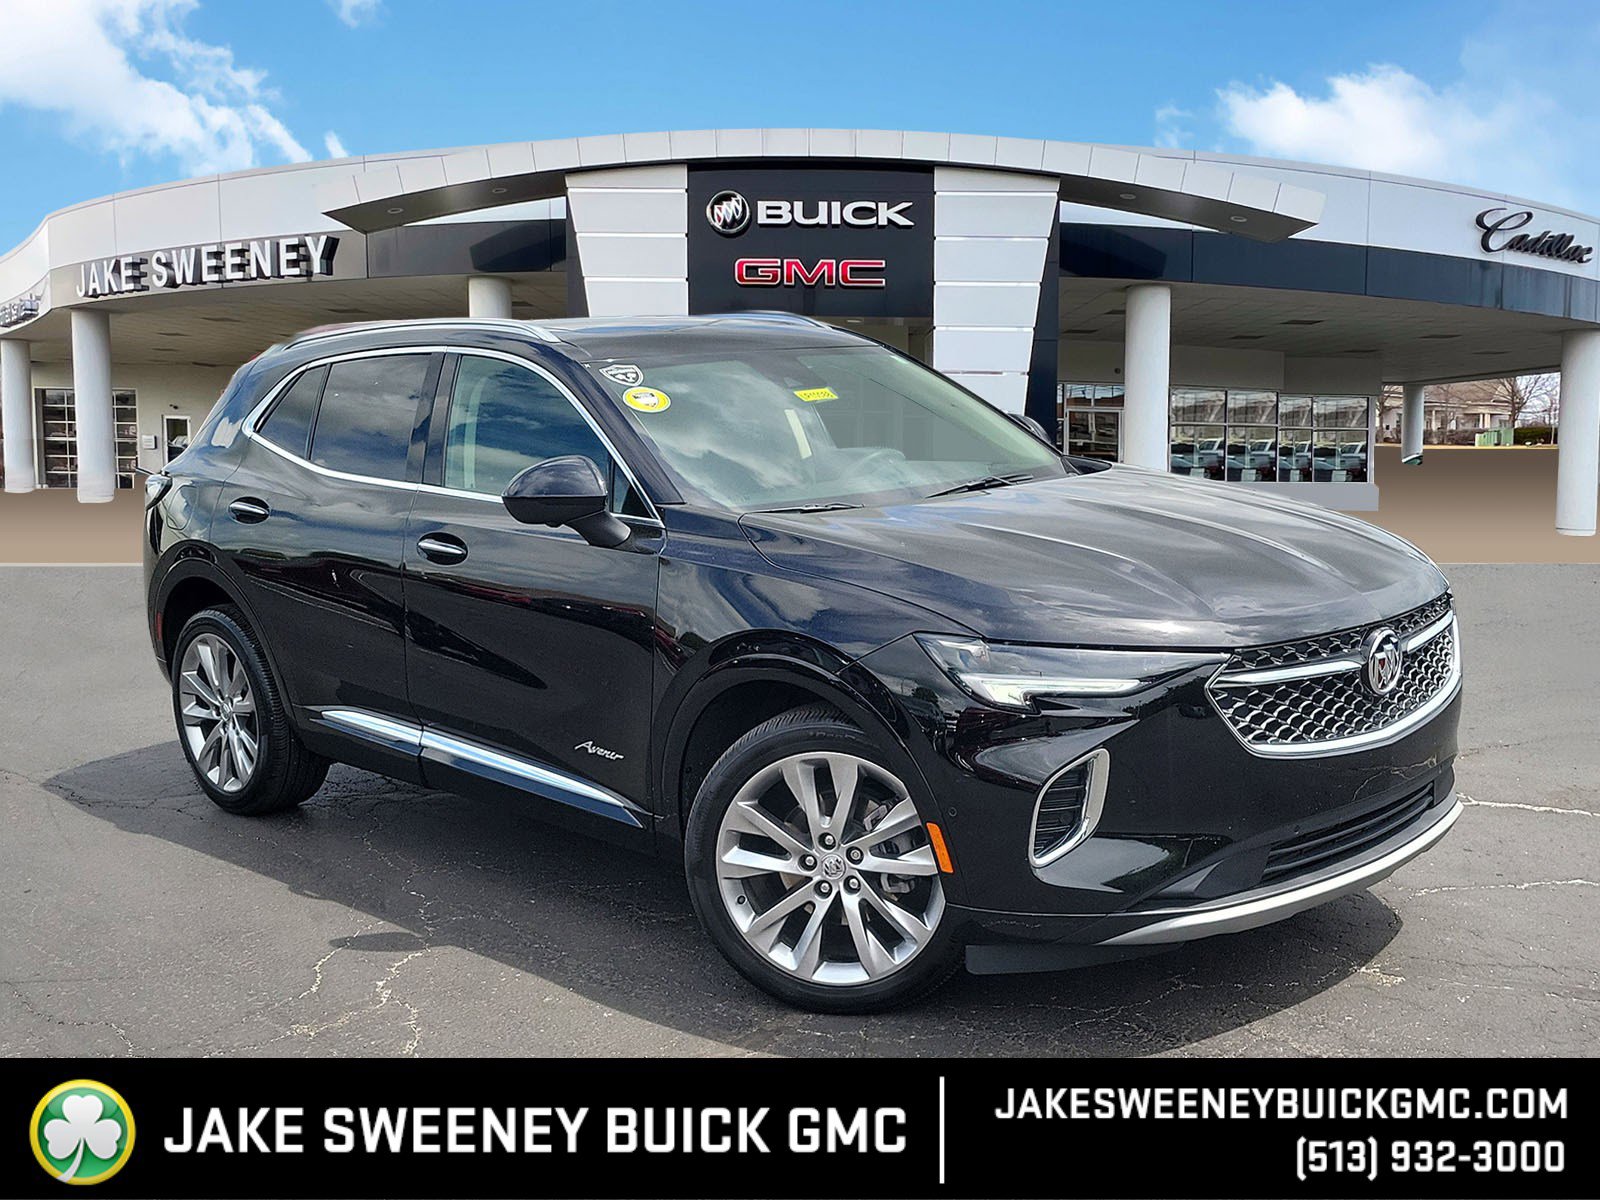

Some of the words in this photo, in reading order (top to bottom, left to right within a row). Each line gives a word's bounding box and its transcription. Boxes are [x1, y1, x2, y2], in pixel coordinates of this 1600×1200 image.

[756, 200, 915, 226] BUICK
[1475, 207, 1593, 264] Cadillac
[76, 256, 144, 298] JAKE
[151, 234, 335, 288] SWEENEY
[734, 258, 886, 287] GMC
[574, 740, 625, 761] Avenir
